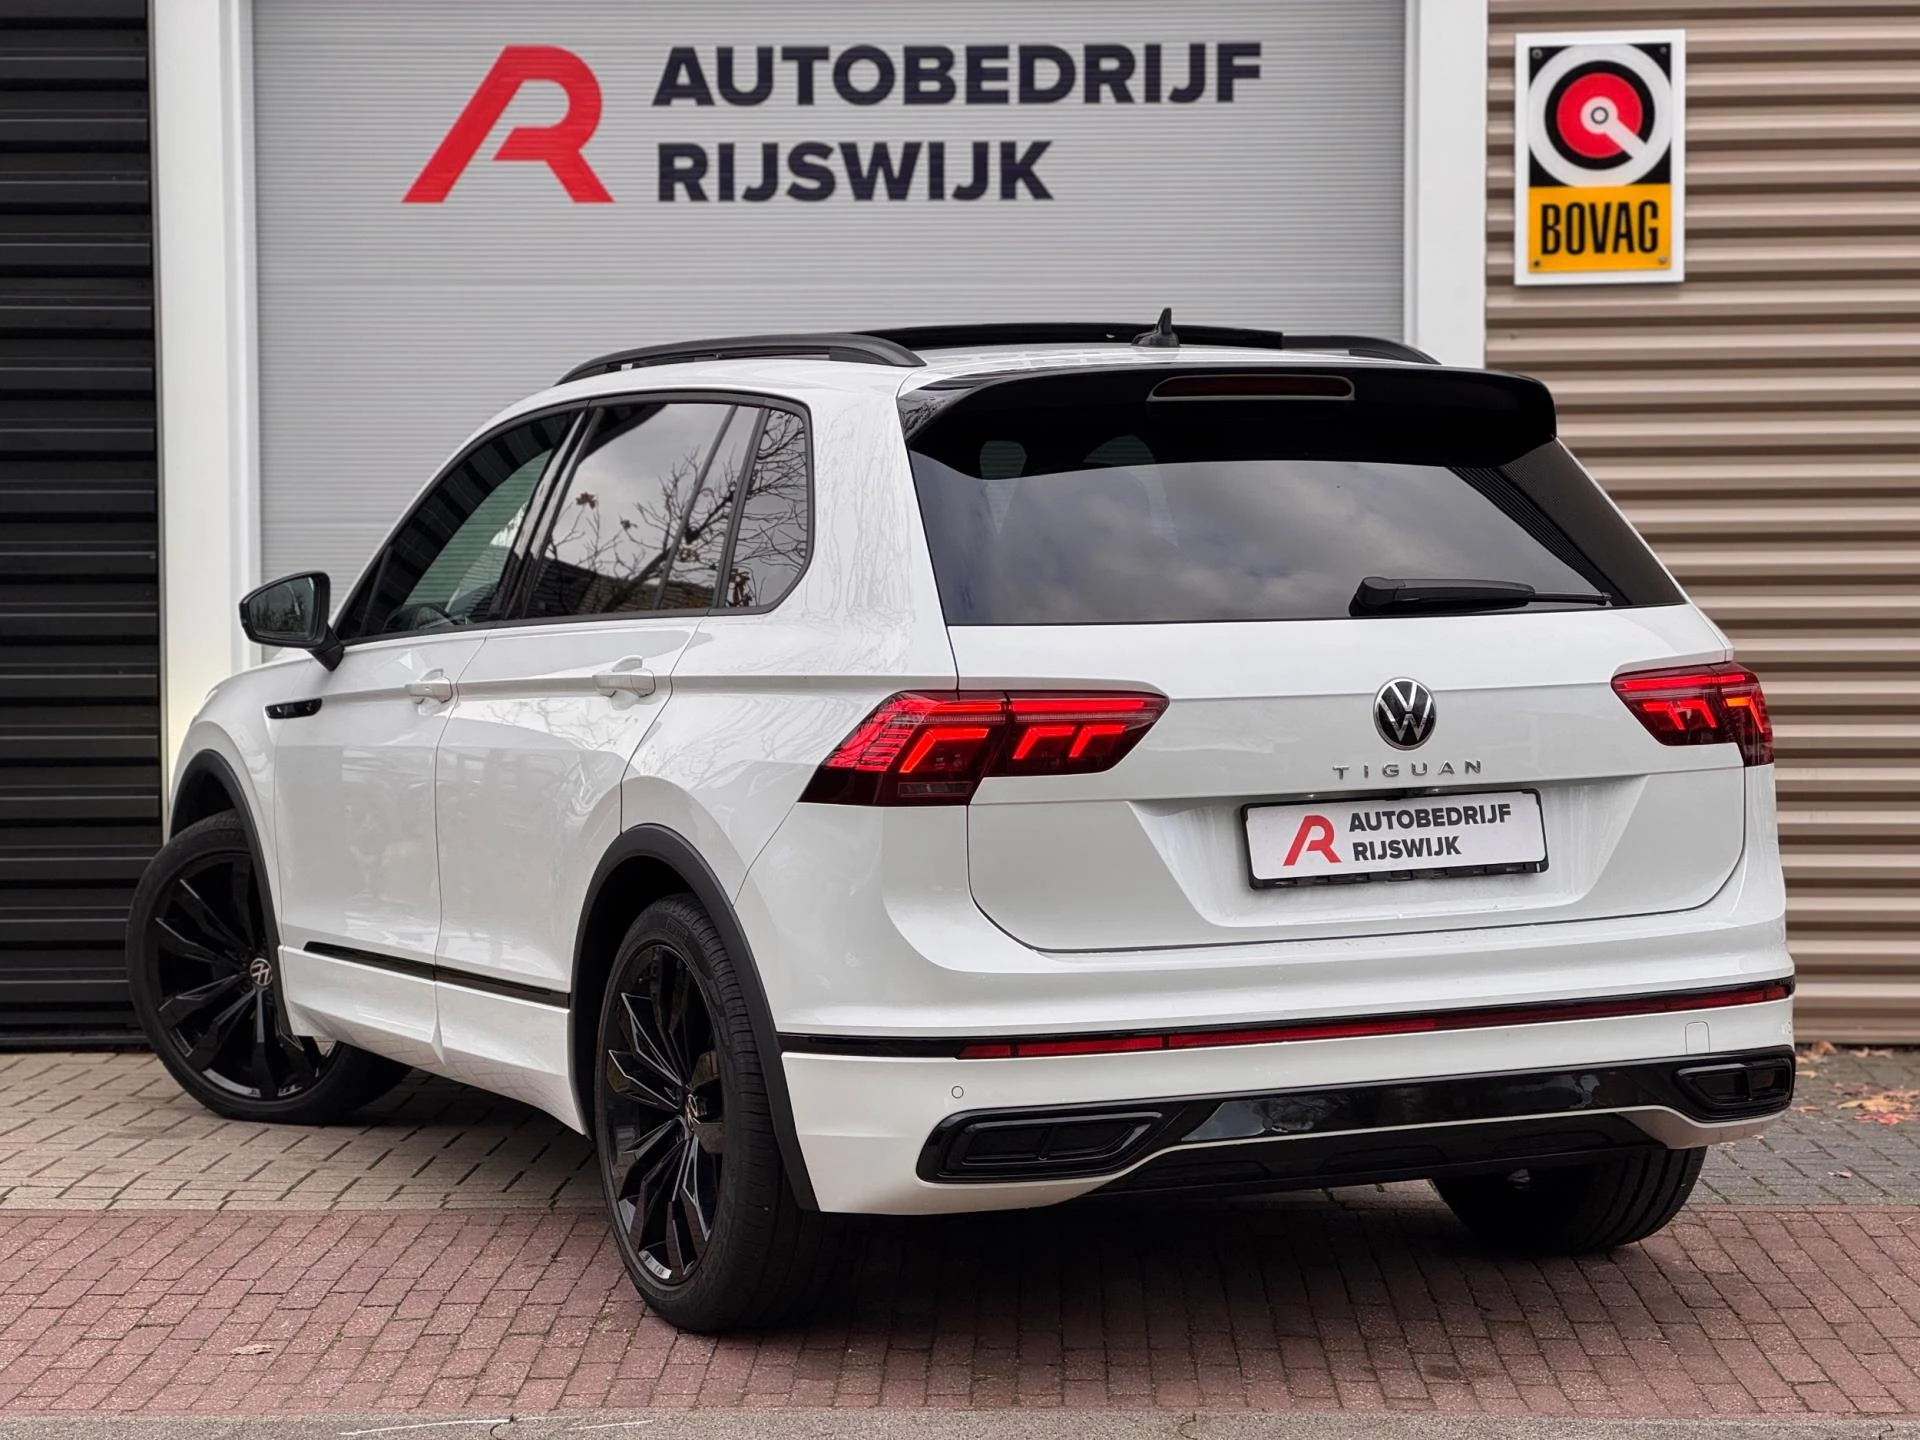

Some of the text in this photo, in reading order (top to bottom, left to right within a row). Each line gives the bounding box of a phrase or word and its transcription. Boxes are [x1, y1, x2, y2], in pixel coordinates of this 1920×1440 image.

[652, 41, 1262, 106] AUTOBEDRIJF
[657, 140, 1055, 202] RIJSWIJK
[1541, 200, 1659, 256] BOVAG
[1332, 759, 1483, 780] TIGUAN
[1348, 803, 1512, 833] AUTOBEDRIJF
[1352, 835, 1463, 862] RIJSWIJK
